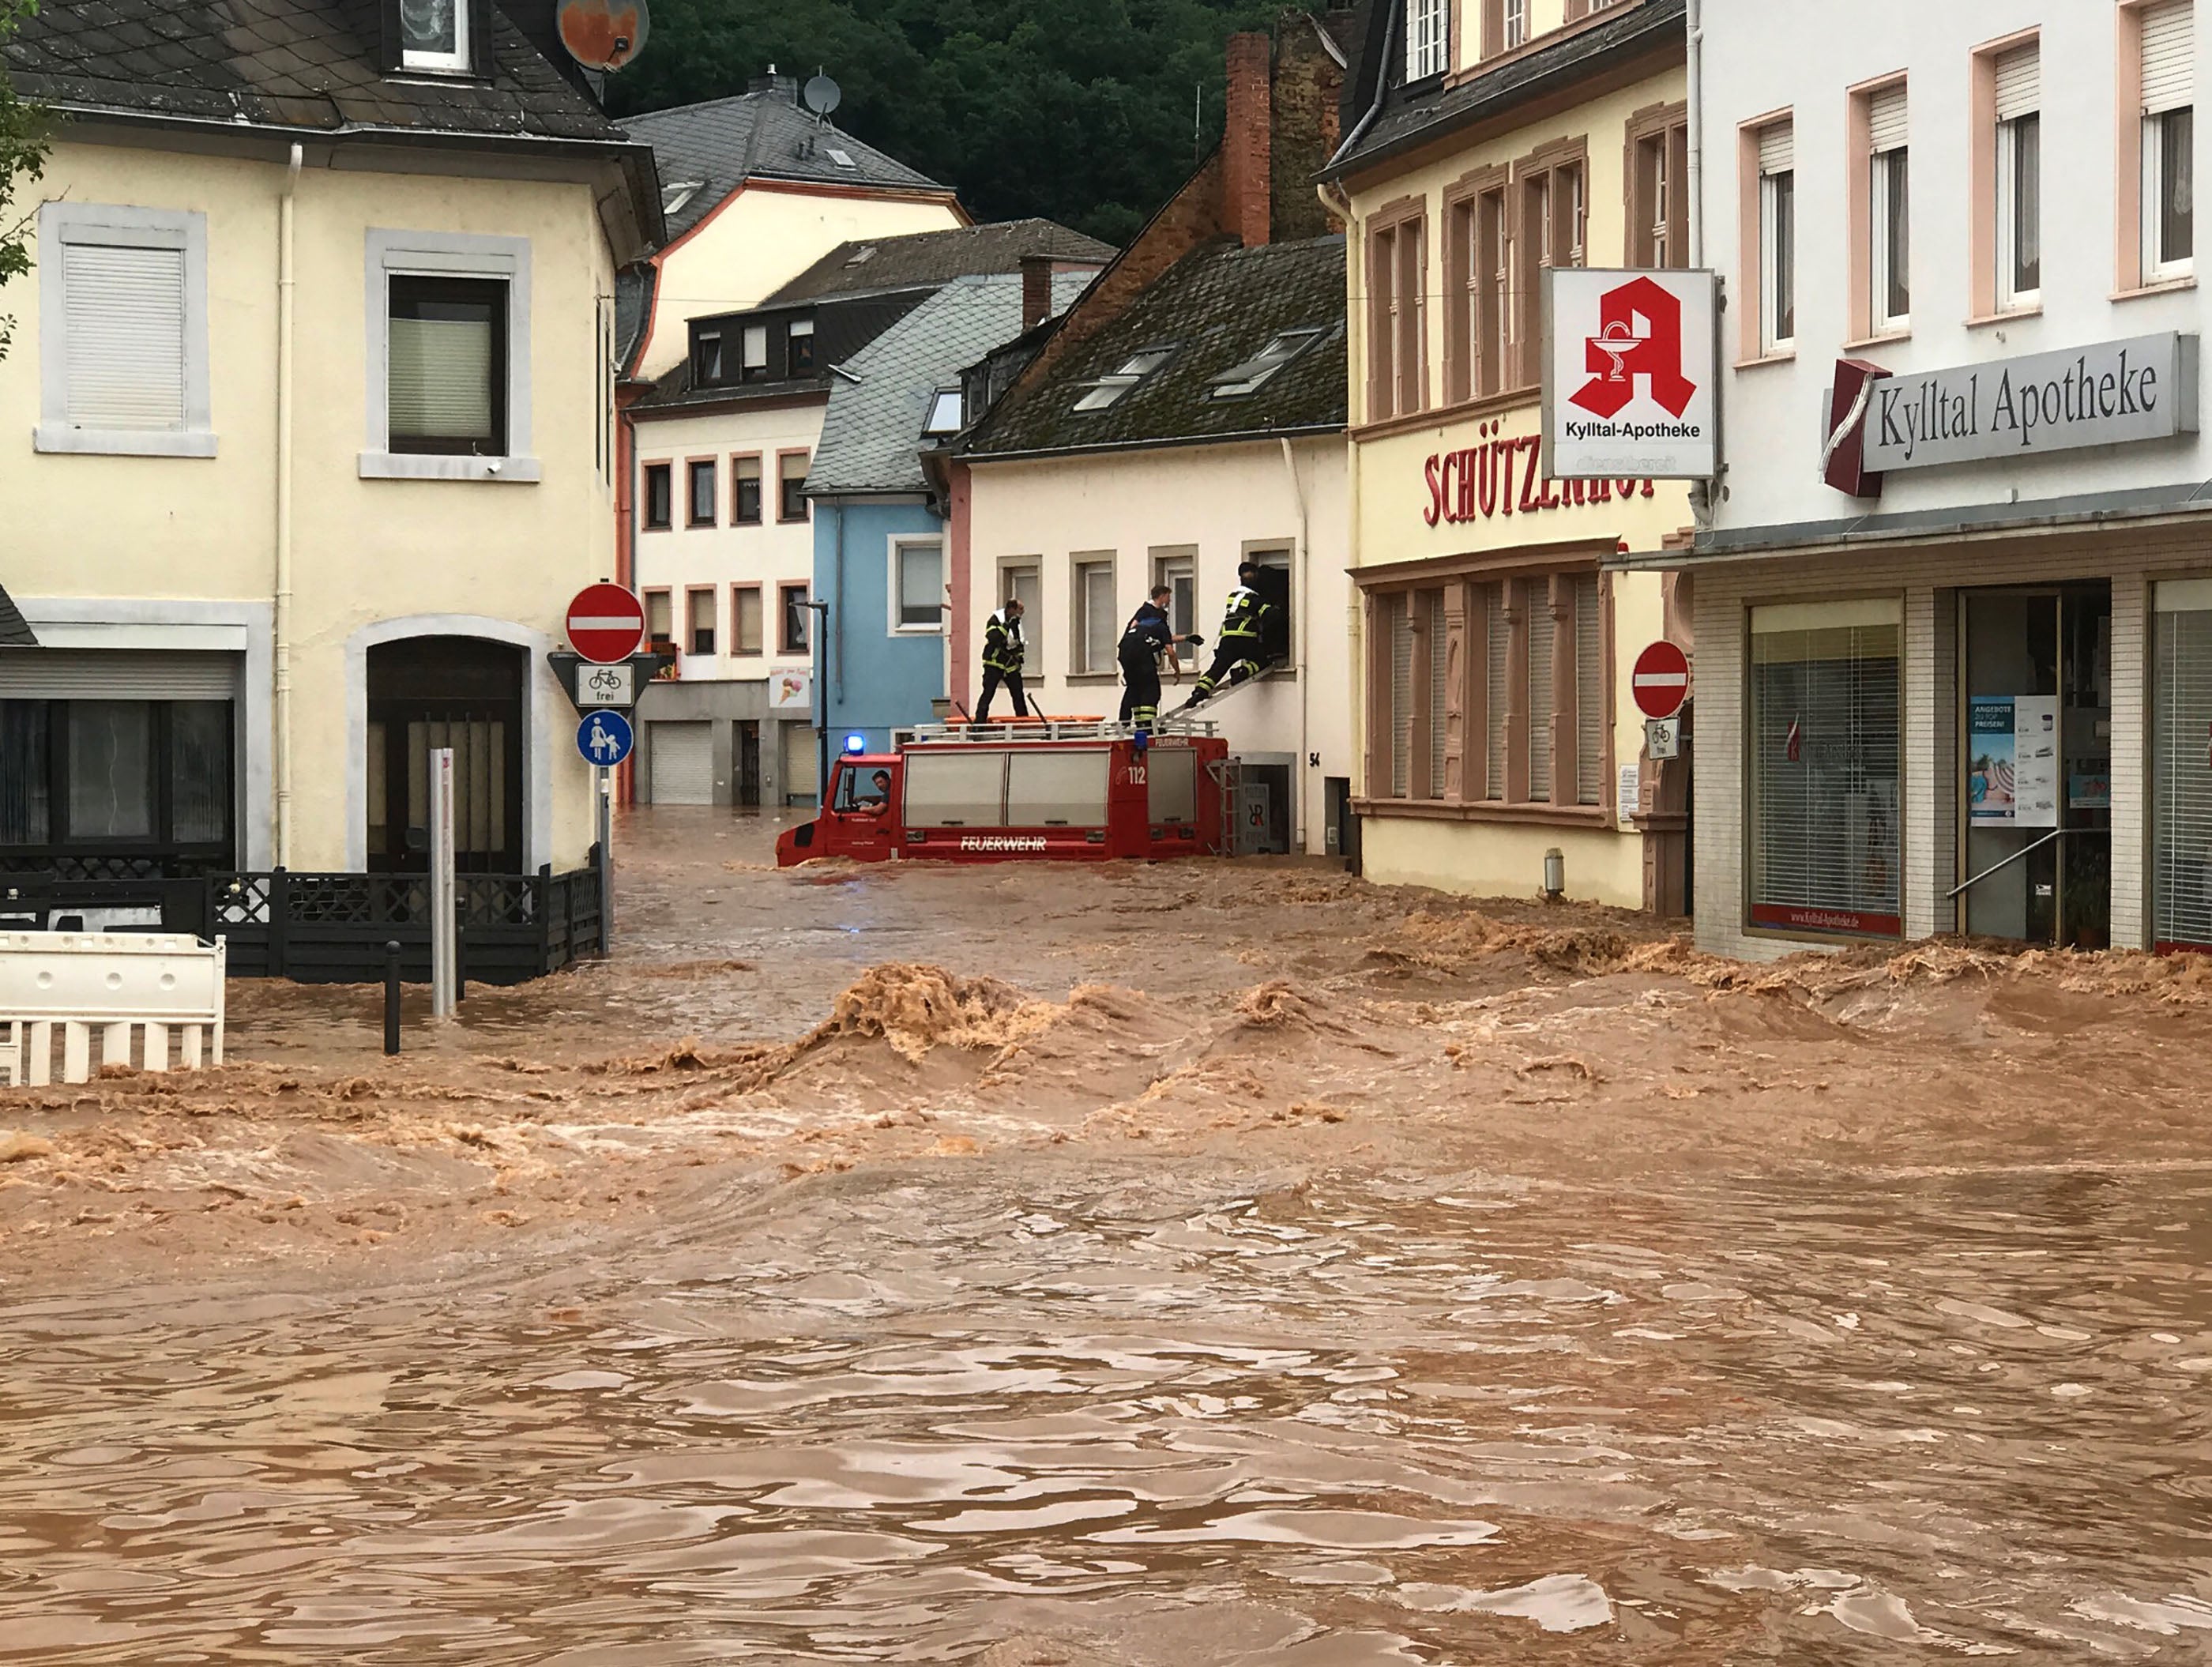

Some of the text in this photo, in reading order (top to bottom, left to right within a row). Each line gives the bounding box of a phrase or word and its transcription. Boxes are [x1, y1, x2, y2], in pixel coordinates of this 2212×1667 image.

[1879, 349, 2157, 461] Kylltal Apotheke
[1566, 422, 1700, 441] Kylltal-Apotheke
[596, 691, 614, 701] frei
[1128, 766, 1146, 785] 112
[961, 836, 1047, 851] FEUERWEHR
